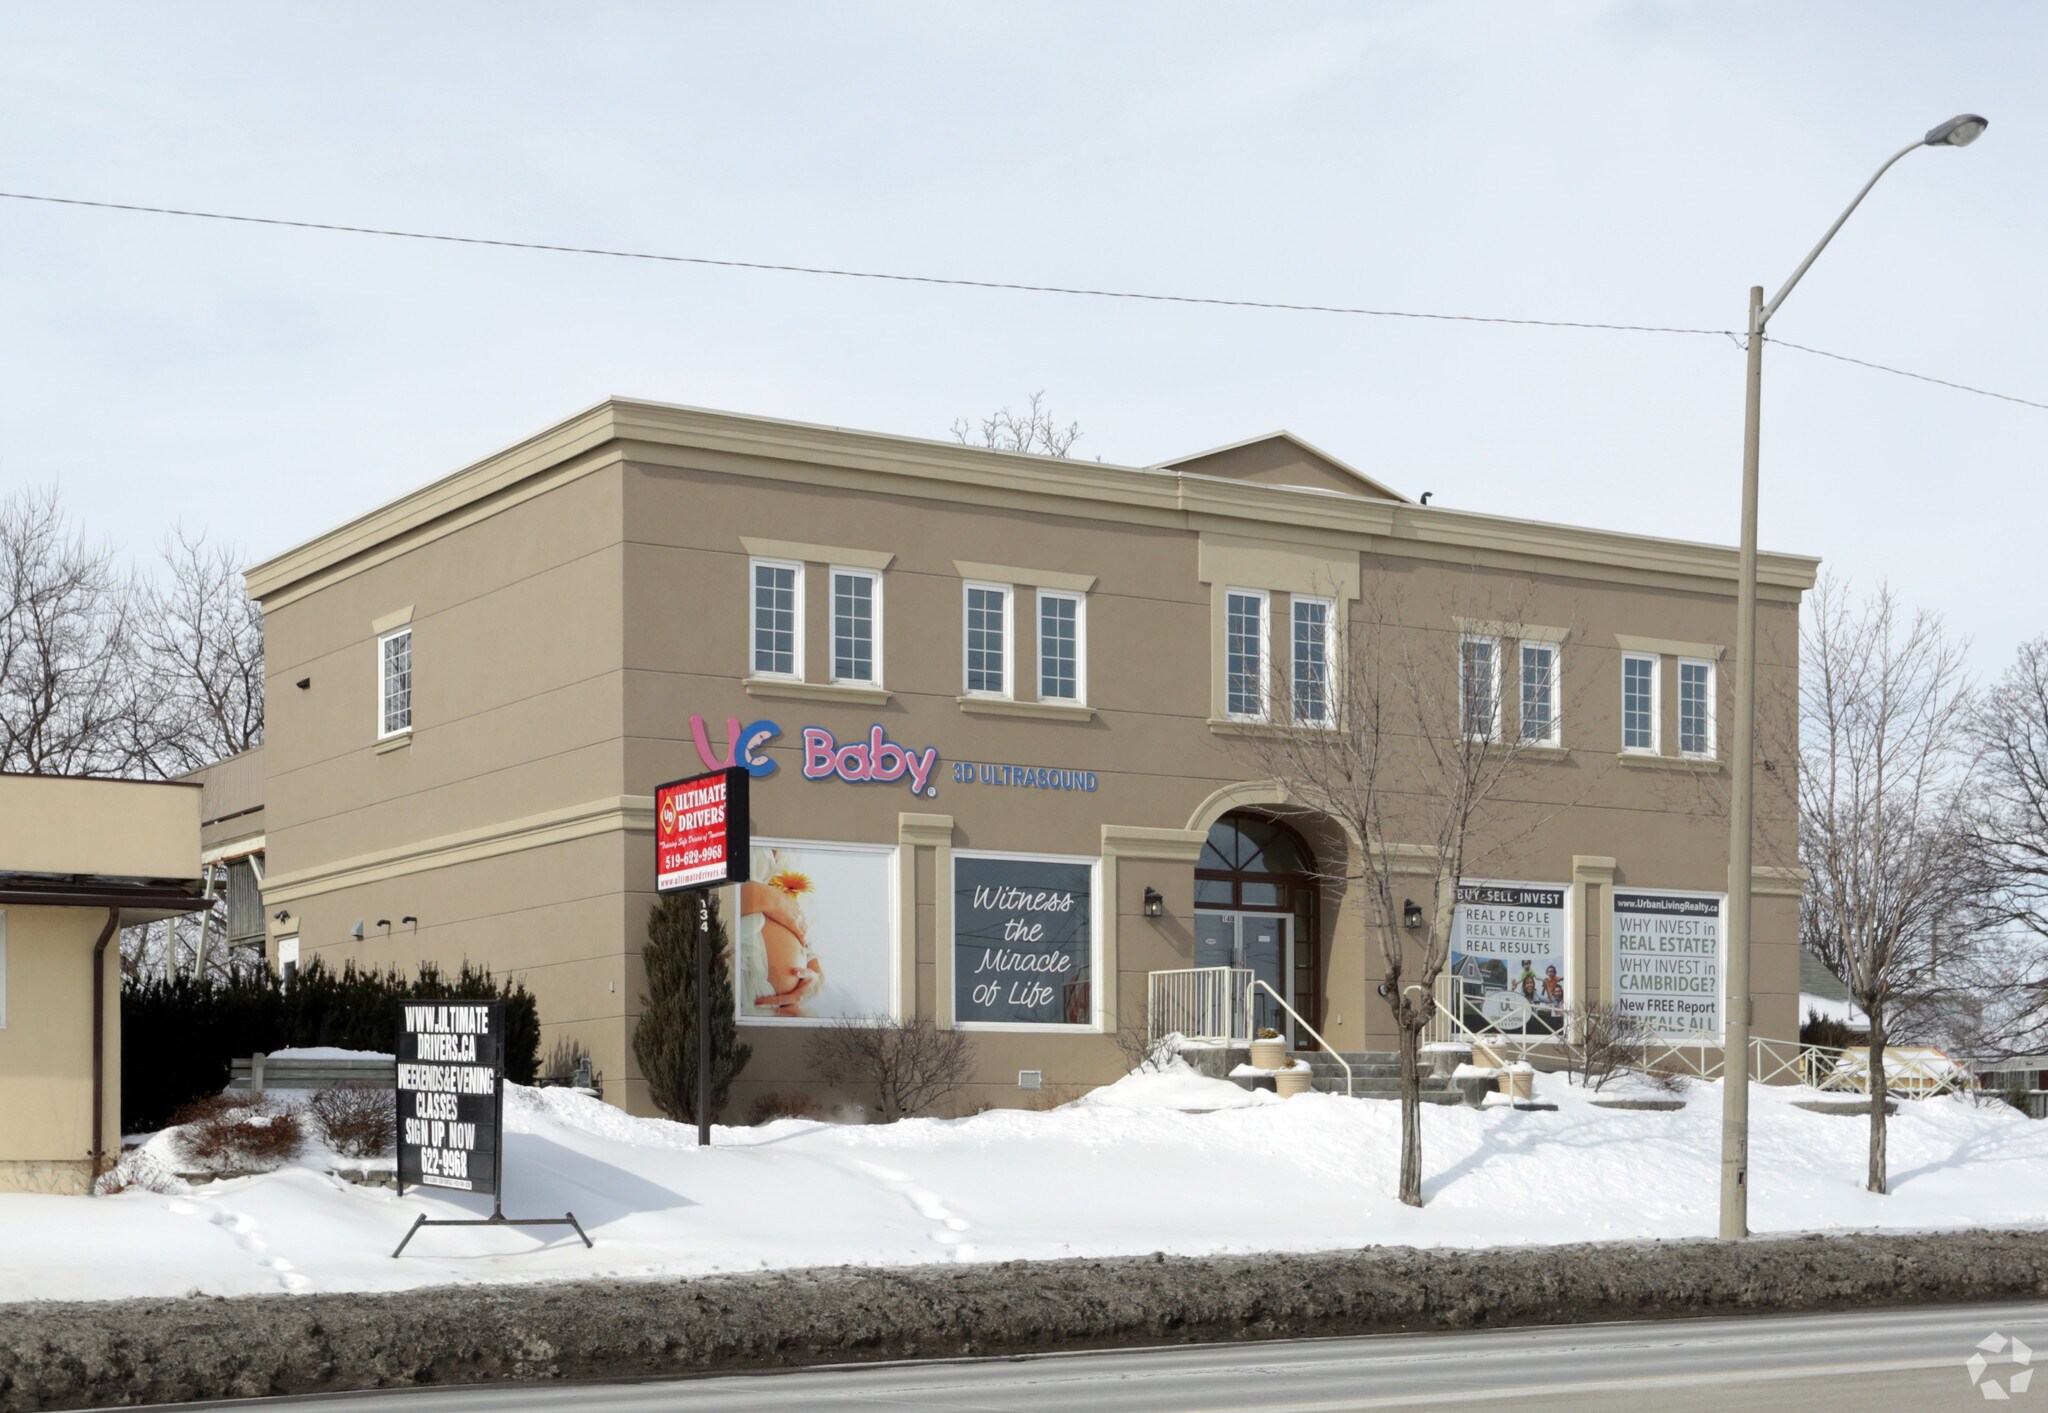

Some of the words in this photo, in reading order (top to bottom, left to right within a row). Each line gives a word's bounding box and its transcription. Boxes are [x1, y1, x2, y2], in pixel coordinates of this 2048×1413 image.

[951, 763, 976, 784] 3D
[979, 764, 1097, 792] ULTRASOUND
[675, 783, 727, 812] ULTIMATE
[665, 844, 723, 870] 519-622-9968
[973, 885, 1074, 911] Witness
[1457, 888, 1480, 901] BUY
[1486, 890, 1513, 903] SELL
[1520, 892, 1560, 905] INVEST
[1617, 898, 1718, 913] www.UrbanLivingRealty.ca
[1466, 909, 1495, 921] REAL
[1500, 910, 1550, 924] PEOPLE
[1620, 917, 1651, 933] WHY
[1655, 919, 1700, 935] INVEST
[1704, 922, 1716, 936] in
[1004, 918, 1044, 942] the
[1466, 924, 1495, 936] REAL
[1500, 925, 1551, 938] WEALTH
[1466, 940, 1495, 952] REAL
[1500, 941, 1550, 955] RESULTS
[1620, 935, 1656, 951] REAL
[1659, 936, 1716, 954] ESTATE?
[974, 948, 1072, 974] Miracle
[1620, 957, 1651, 973] WHY
[1655, 959, 1700, 975] INVEST
[1704, 961, 1716, 975] in
[972, 980, 1001, 1007] of
[1008, 981, 1055, 1008] Life
[1619, 974, 1716, 993] CAMBRIDGE?
[1620, 998, 1645, 1012] New
[1647, 998, 1675, 1013] FREE
[1677, 1000, 1716, 1016] Report
[404, 1006, 489, 1034] WWW.ULTIMATE
[417, 1033, 477, 1062] DRIVERS.CA
[416, 1091, 458, 1121] CLASSES
[405, 1117, 429, 1146] SIGN
[431, 1120, 445, 1148] UP
[448, 1121, 476, 1151] NOW
[421, 1146, 468, 1179] 622-9968
